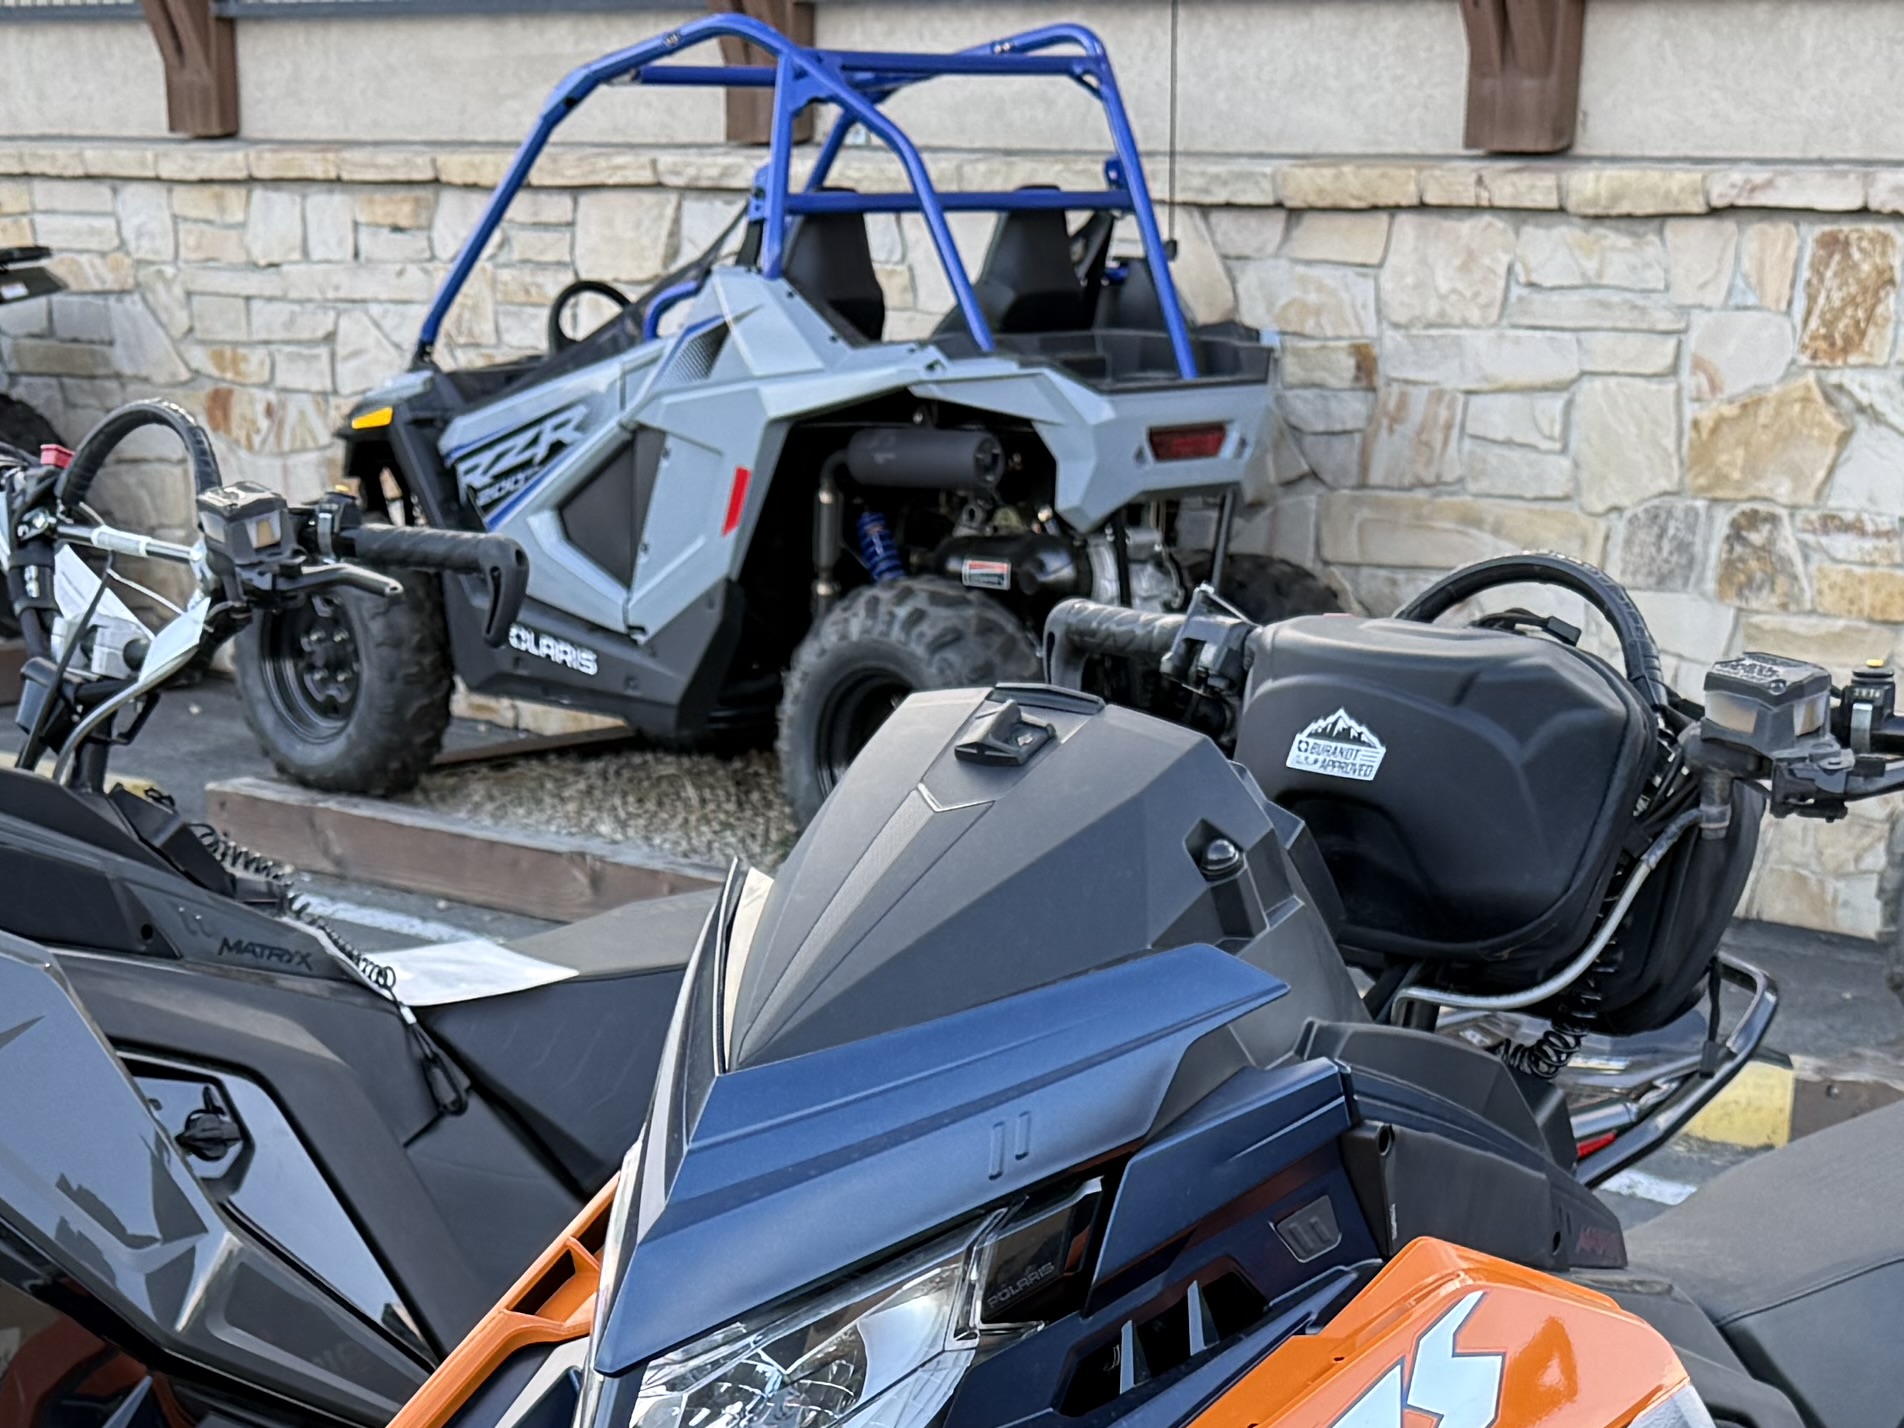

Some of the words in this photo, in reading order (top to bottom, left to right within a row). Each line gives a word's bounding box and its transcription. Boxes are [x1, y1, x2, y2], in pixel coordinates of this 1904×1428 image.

[456, 403, 590, 505] RZR
[508, 624, 598, 676] OLARIS
[1318, 758, 1374, 779] APPROVED
[217, 936, 313, 972] MATRYX
[987, 1262, 1055, 1308] POLARIS
